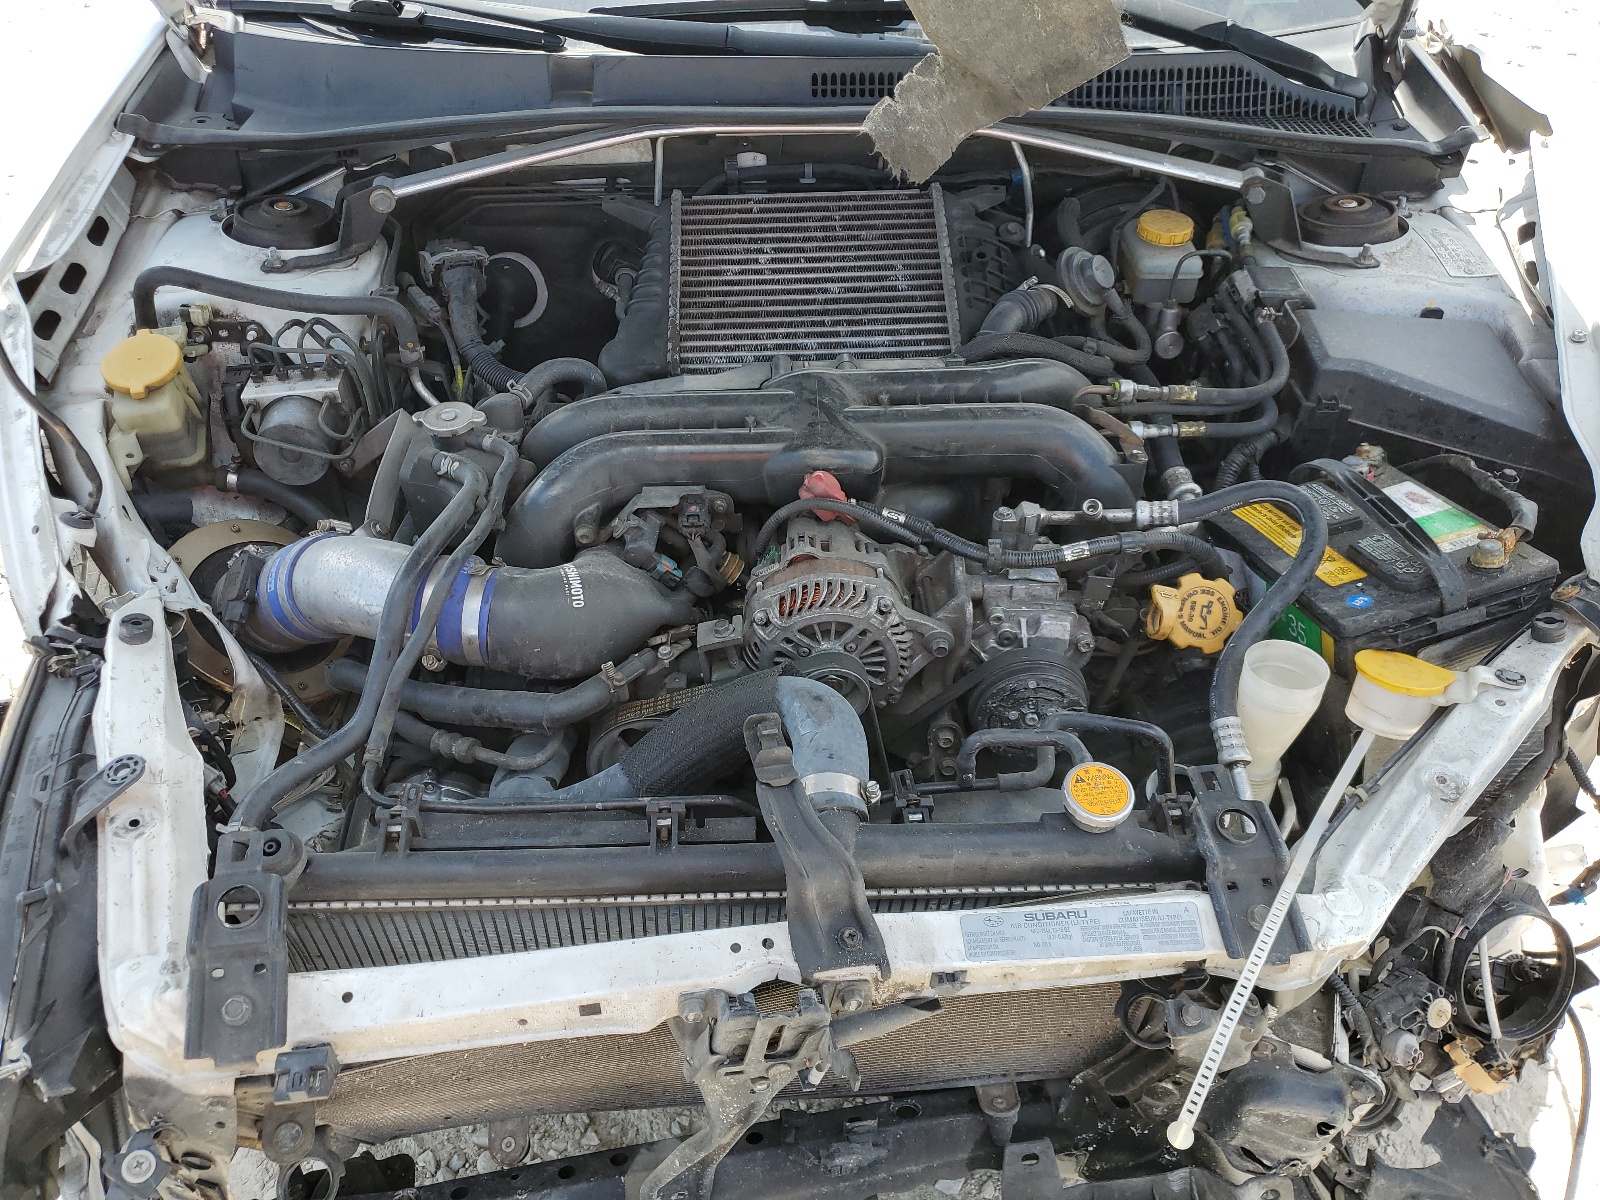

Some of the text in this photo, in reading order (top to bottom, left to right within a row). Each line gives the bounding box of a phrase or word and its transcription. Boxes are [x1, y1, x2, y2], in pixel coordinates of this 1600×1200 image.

[564, 564, 584, 608] ISHIMOTO
[1217, 596, 1228, 625] ENGINE
[1288, 614, 1306, 645] 35
[1024, 910, 1088, 921] SUBARU
[1024, 920, 1069, 928] CONDITIONER
